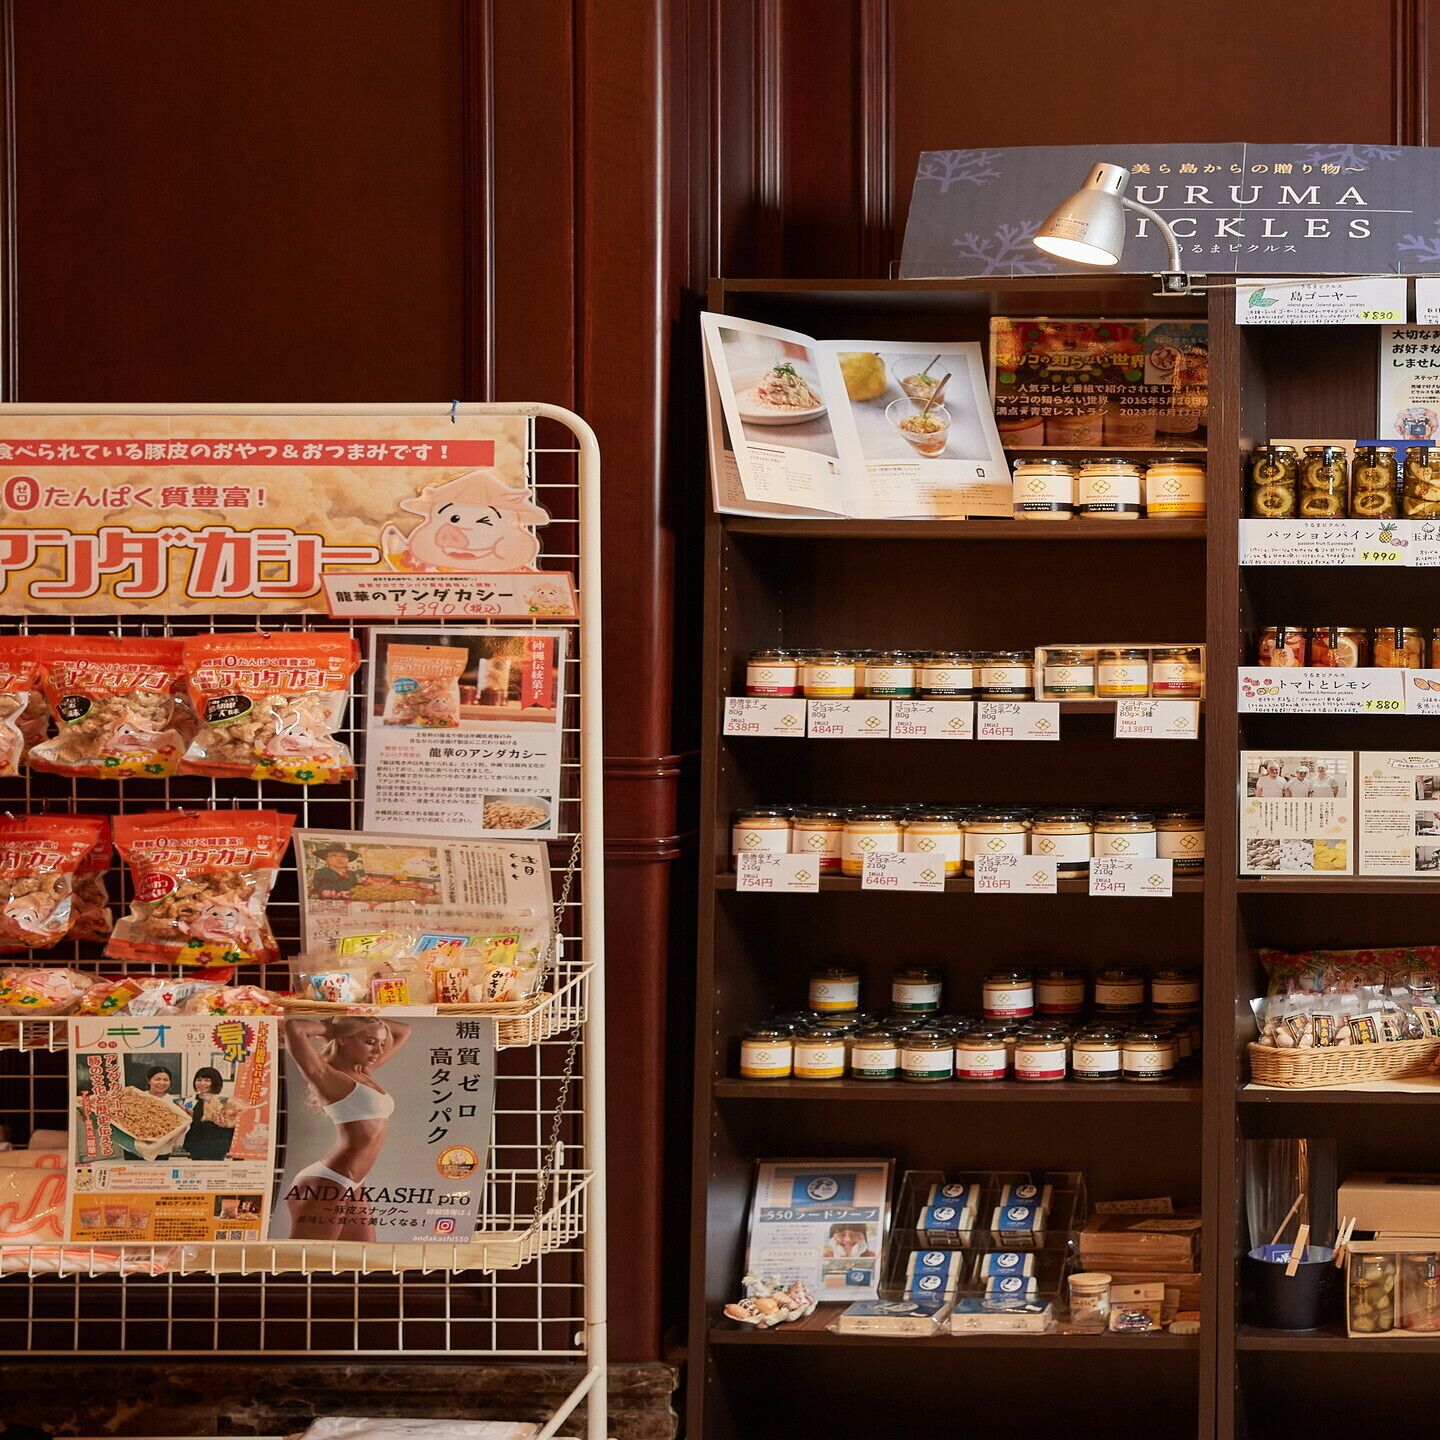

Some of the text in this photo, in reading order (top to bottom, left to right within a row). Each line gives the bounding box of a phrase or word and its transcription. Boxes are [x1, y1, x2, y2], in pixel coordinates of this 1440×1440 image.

[1134, 185, 1368, 206] URUMA
[1134, 218, 1372, 239] ICKLES
[1289, 291, 1358, 301] 島ゴーヤー
[1362, 310, 1394, 320] ¥830
[997, 395, 1109, 405] マツコの知らない世界
[1266, 530, 1376, 540] パッションパイン
[1362, 551, 1397, 562] ¥990
[335, 588, 514, 603] 龍華のアンダカシー
[531, 640, 546, 700] 沖縄伝統菓子
[1278, 679, 1372, 690] トマトとレモン
[729, 703, 767, 711] マヨネーズ
[812, 705, 851, 713] マヨネーズ
[896, 706, 934, 714] マヨネーズ
[1366, 700, 1400, 710] ¥880
[728, 709, 743, 717] 80g
[811, 711, 827, 719] 80g
[728, 722, 760, 732] 538円
[811, 725, 844, 734] 484円
[895, 726, 927, 735] 538円
[981, 727, 1014, 736] 646円
[1119, 725, 1153, 734] 2,138円
[429, 747, 548, 759] 龍華のアンダカシー
[741, 878, 773, 887] 754円
[866, 876, 898, 886] 646円
[978, 880, 1011, 889] 916円
[1093, 883, 1126, 892] 754円
[455, 1020, 481, 1119] 糖質ゼロ
[428, 1047, 453, 1145] 高タンパク
[285, 1185, 471, 1206] ANDAKASHI pro
